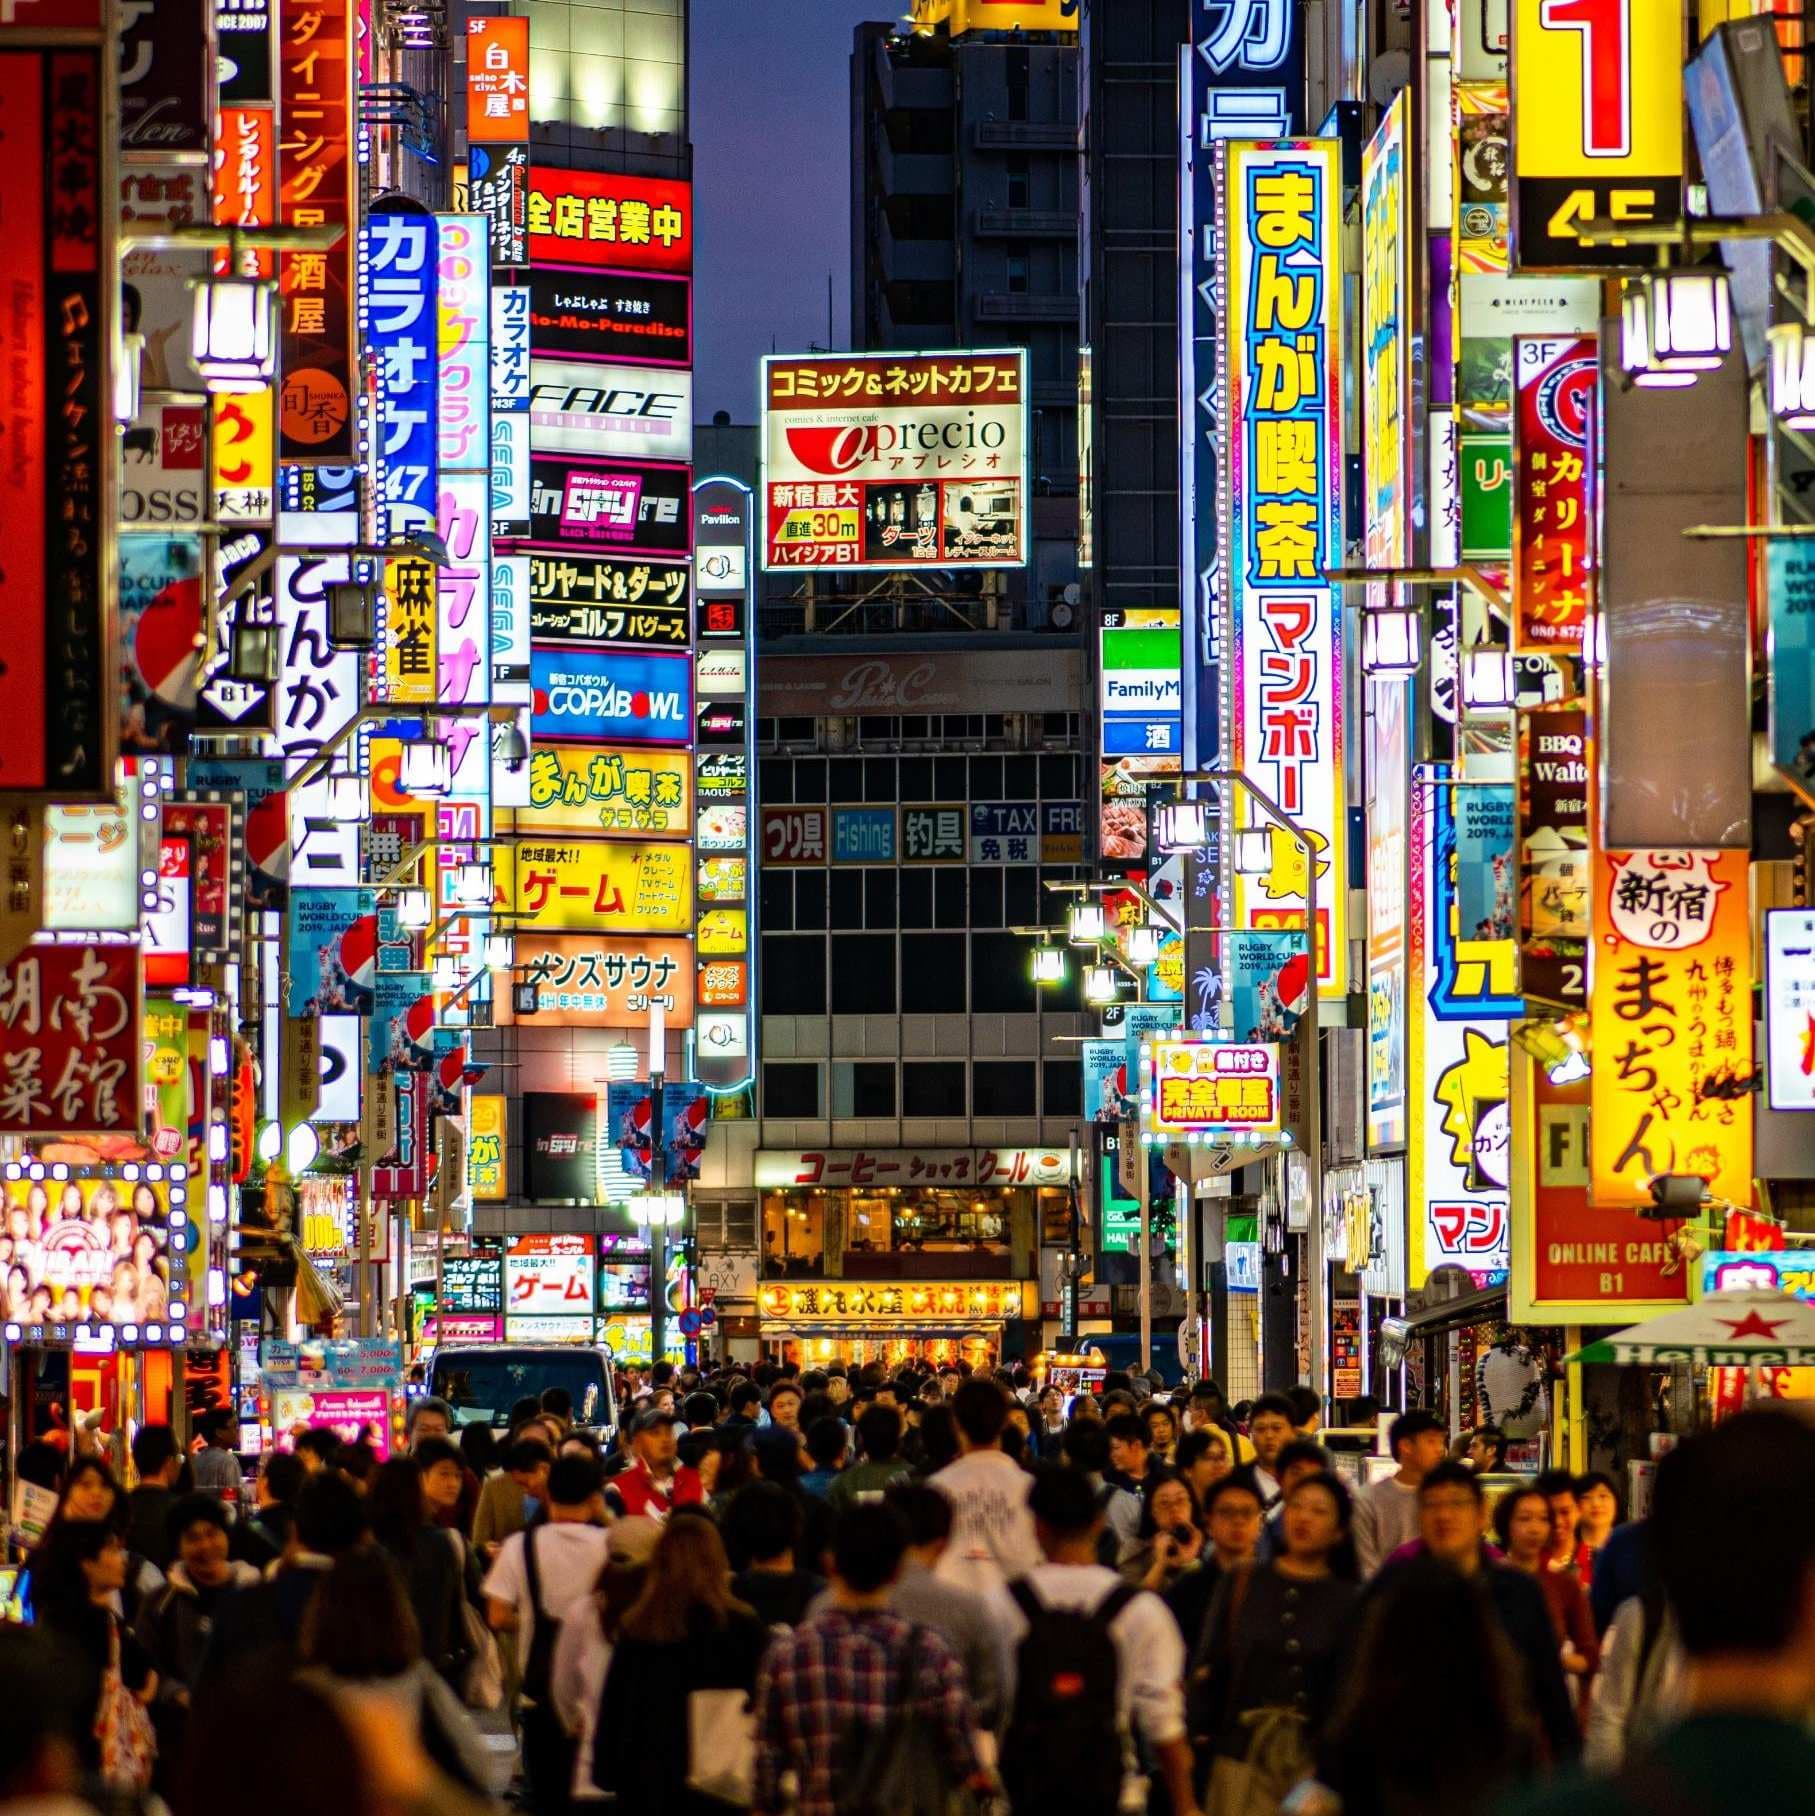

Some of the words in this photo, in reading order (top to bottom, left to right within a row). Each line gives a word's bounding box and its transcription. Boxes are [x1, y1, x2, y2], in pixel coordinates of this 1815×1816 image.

[483, 42, 527, 118] 白木屋
[528, 190, 682, 249] 全店営業中
[554, 294, 608, 310] しゃぶしゃぶ
[503, 290, 527, 395] カラオケ
[1523, 343, 1557, 364] 3F
[772, 365, 1018, 398] コミック&ネットカフェ
[1254, 172, 1318, 578] まんが喫茶
[530, 383, 685, 418] FACE
[830, 410, 1007, 470] aprecio
[491, 420, 513, 511] SEGA
[887, 453, 1002, 470] アプレシオ
[772, 483, 860, 509] 新宿最大
[701, 514, 741, 525] Pavilion
[786, 513, 856, 539] 直進30m
[882, 527, 937, 547] ダーツ
[1548, 451, 1585, 623] カリーナ
[772, 543, 860, 564] ハイジアB1
[395, 560, 432, 676] 麻雀
[491, 564, 514, 654] SEGA
[1104, 614, 1119, 627] 8F
[1107, 680, 1180, 702] FamilyM
[1265, 603, 1313, 809] マンボー
[1145, 722, 1172, 750] 酒
[1539, 736, 1583, 754] BBQ
[718, 754, 745, 765] ダーツ
[531, 751, 682, 809] まんが喫茶
[600, 807, 668, 832] ゲラゲラ
[993, 808, 1036, 833] TAX
[766, 812, 824, 859] つり具
[836, 815, 892, 858] Fishing
[906, 811, 963, 858] 釣具
[521, 848, 581, 864] 地域最大!!
[979, 840, 1029, 862] 免税
[523, 868, 627, 914] ゲーム
[1616, 871, 1711, 923] 新宿
[1648, 921, 1680, 944] の
[1238, 943, 1273, 953] RUGBY
[1238, 953, 1276, 962] WORLD
[529, 953, 677, 989] メンズサウナ
[1238, 962, 1262, 972] 2019,
[1560, 965, 1584, 995] 2
[1105, 1007, 1120, 1021] 2F
[1162, 1078, 1269, 1107] 完全個室
[1162, 1106, 1222, 1119] PRIVATE
[1227, 1106, 1269, 1119] ROOM
[795, 1152, 900, 1184] コーヒー
[976, 1151, 1030, 1184] クール
[1548, 1243, 1619, 1265] ONLINE
[513, 1273, 590, 1301] ゲーム
[1599, 1272, 1624, 1293] B1
